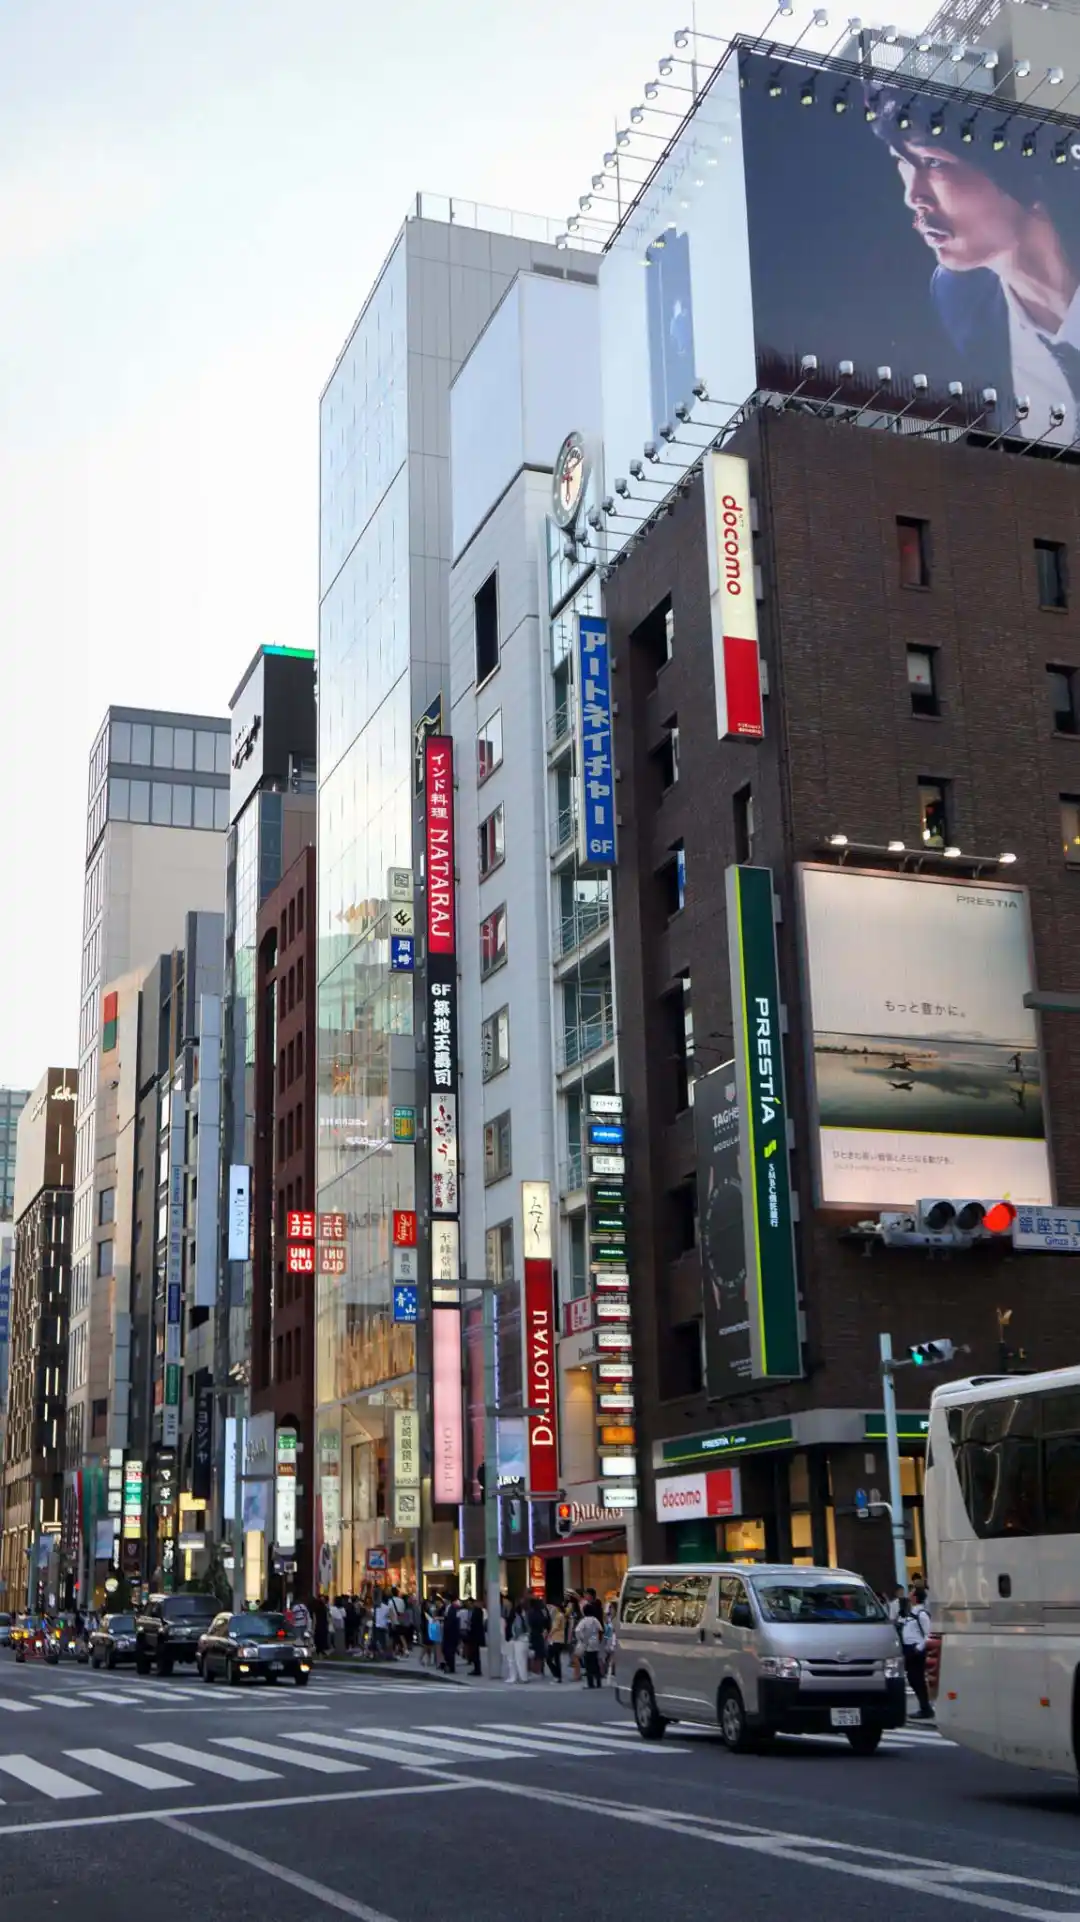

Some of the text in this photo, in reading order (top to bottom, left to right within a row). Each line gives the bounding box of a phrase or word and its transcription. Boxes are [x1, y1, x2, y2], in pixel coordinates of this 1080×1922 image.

[722, 494, 743, 596] docomo
[580, 630, 611, 825] アートネイチャー
[430, 753, 449, 819] インド料理
[591, 838, 613, 854] 6F
[430, 828, 450, 938] NATARAJ
[431, 983, 452, 996] 6F
[885, 1000, 967, 1019] もっと豊かに。
[1045, 1235, 1069, 1247] Ginza
[291, 1247, 311, 1258] UNI
[290, 1259, 312, 1270] QLO
[532, 1310, 554, 1446] DALLOYAU
[662, 1487, 701, 1508] docomo
